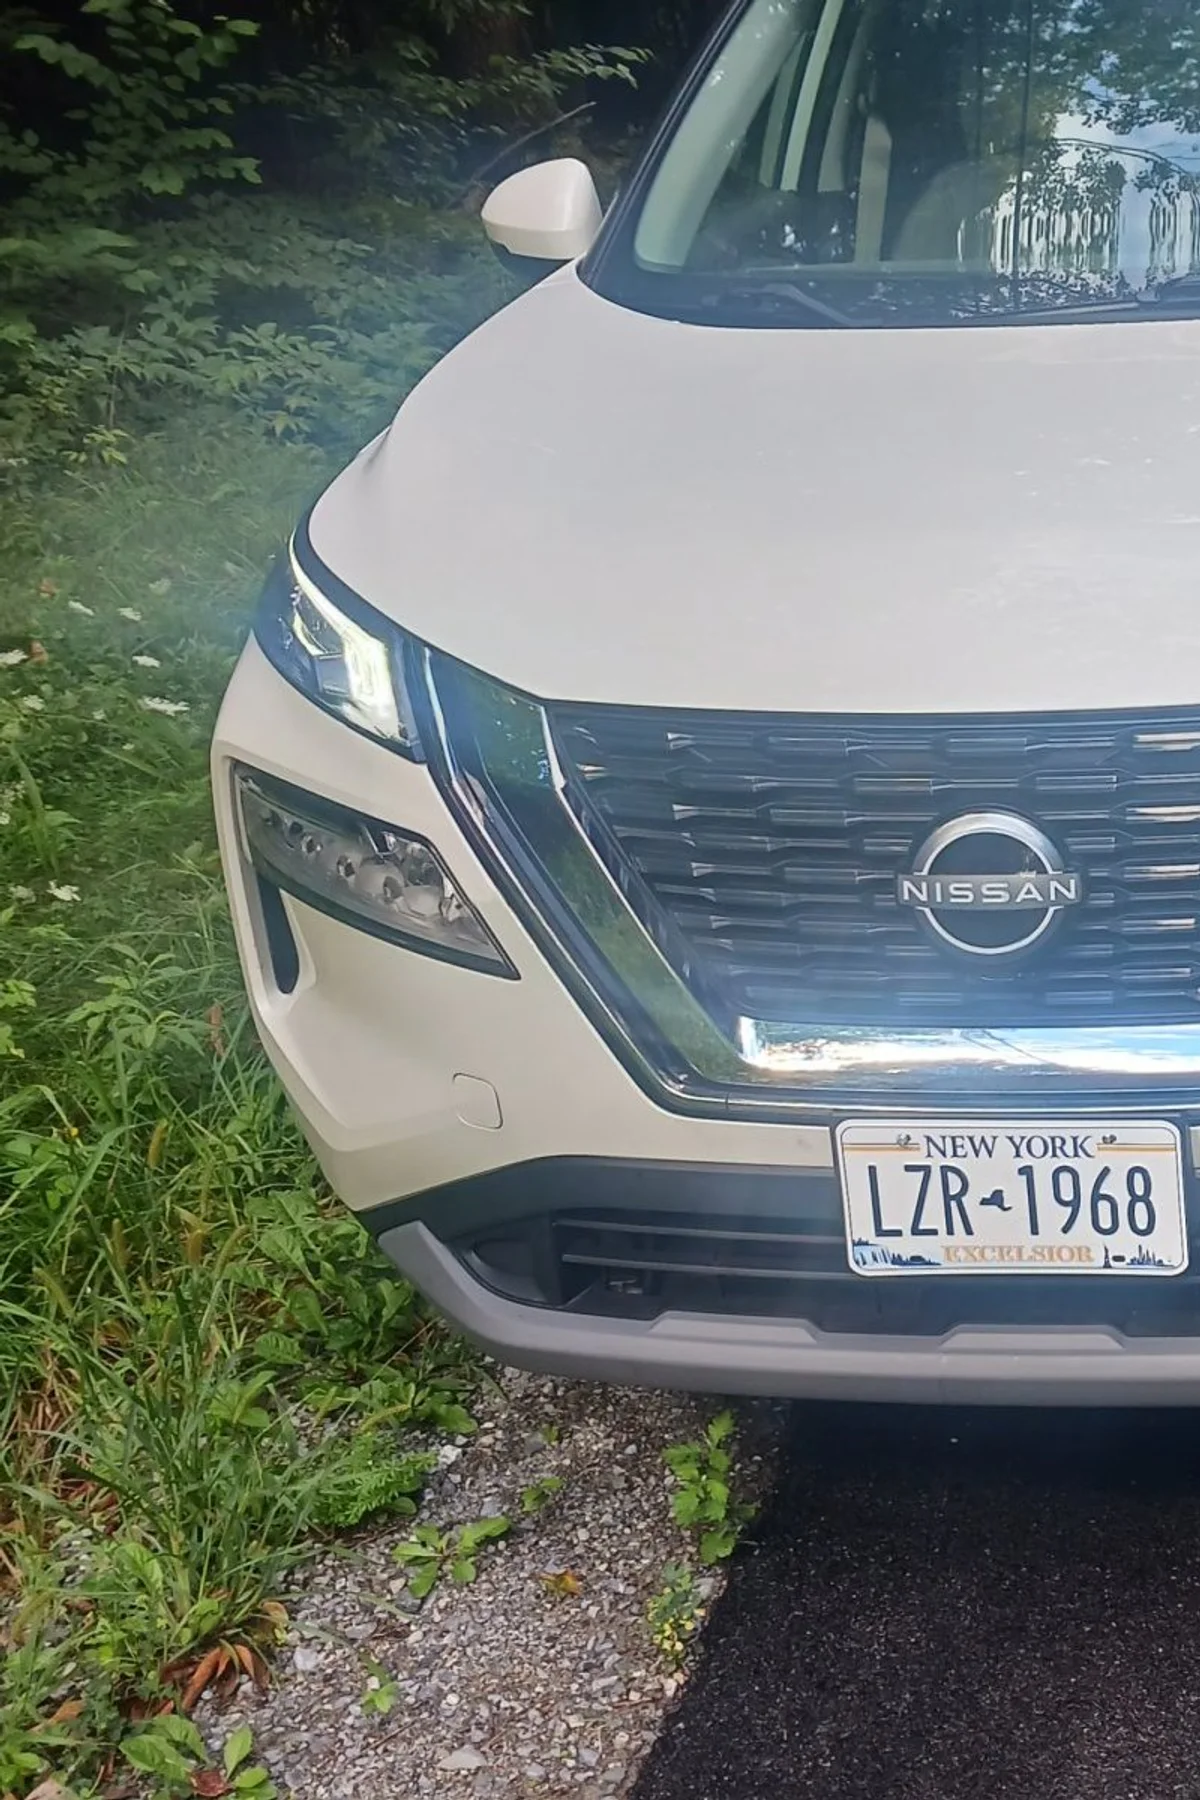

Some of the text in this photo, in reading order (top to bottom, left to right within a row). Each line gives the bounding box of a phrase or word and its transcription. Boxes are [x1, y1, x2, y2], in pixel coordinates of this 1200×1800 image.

[902, 878, 1076, 903] NISSAN
[924, 1134, 1096, 1159] NEW YORK
[867, 1164, 1157, 1238] LZR 1968
[941, 1244, 1095, 1264] EXCELSIOR
